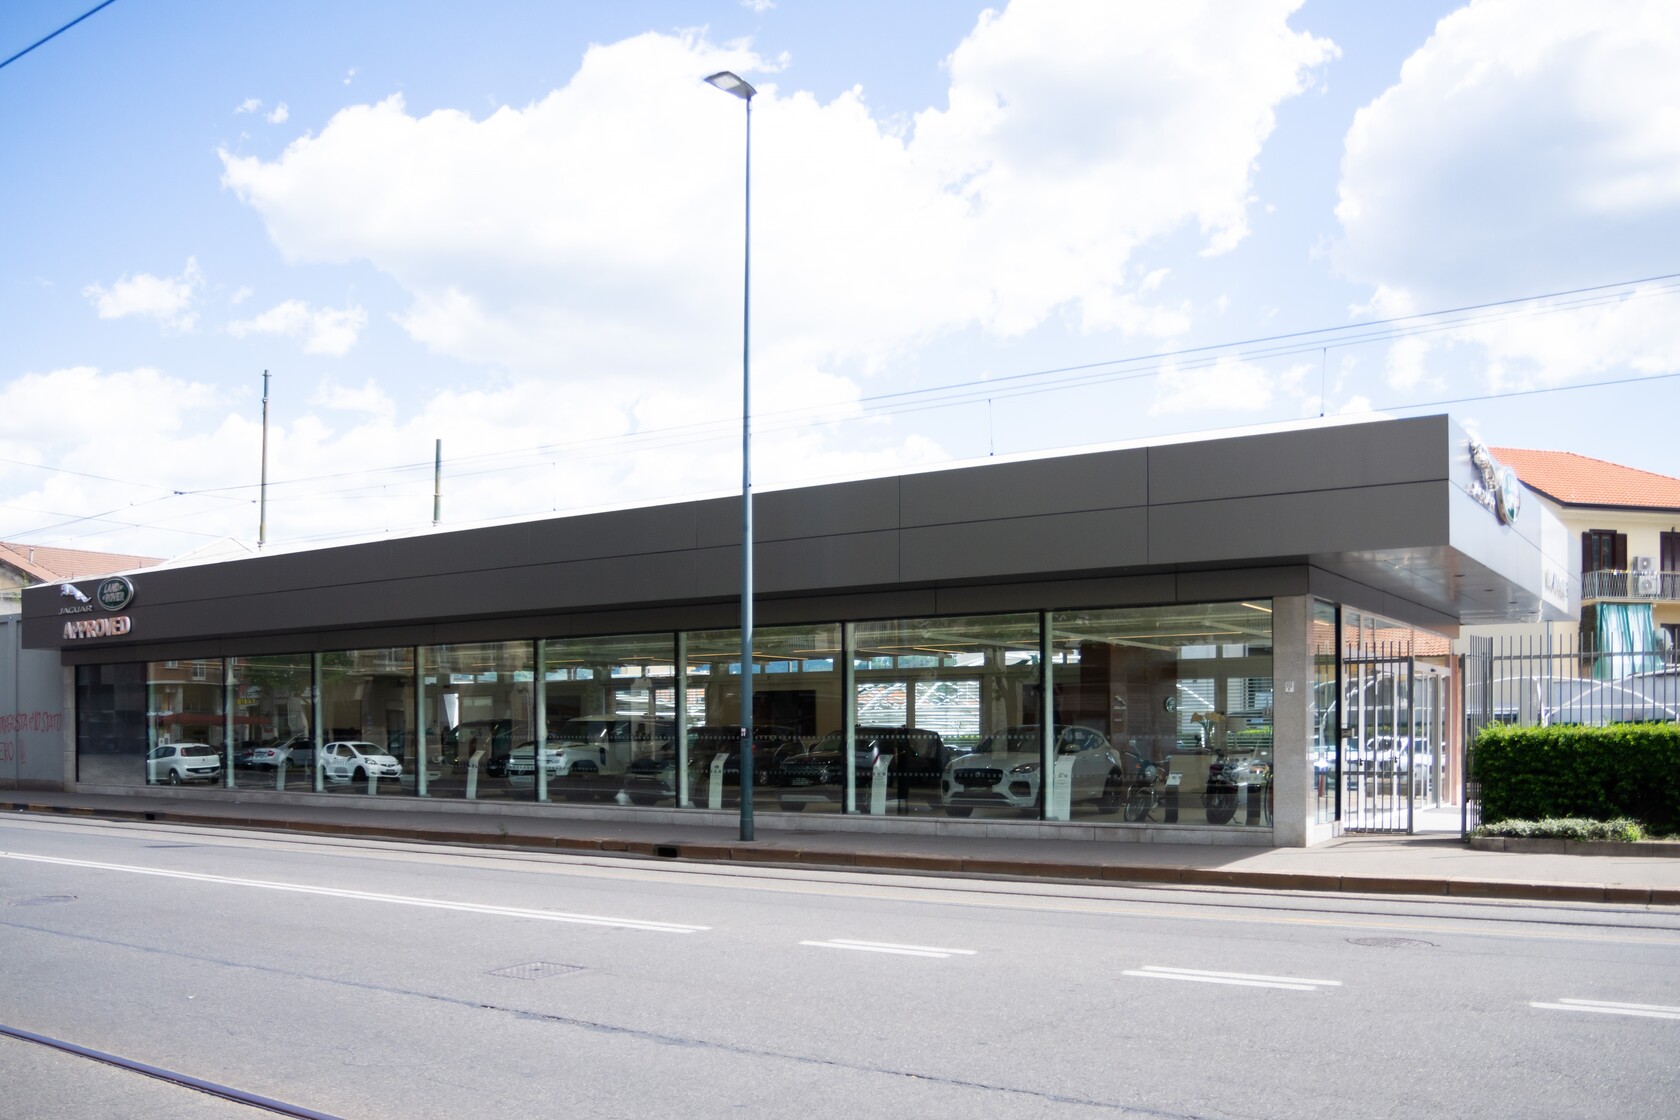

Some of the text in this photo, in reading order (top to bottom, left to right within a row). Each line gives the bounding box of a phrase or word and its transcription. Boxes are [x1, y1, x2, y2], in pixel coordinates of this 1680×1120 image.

[104, 582, 120, 593] LAND
[105, 592, 124, 602] ROVER
[58, 605, 93, 615] JAGUAR
[63, 616, 131, 639] APPROVED
